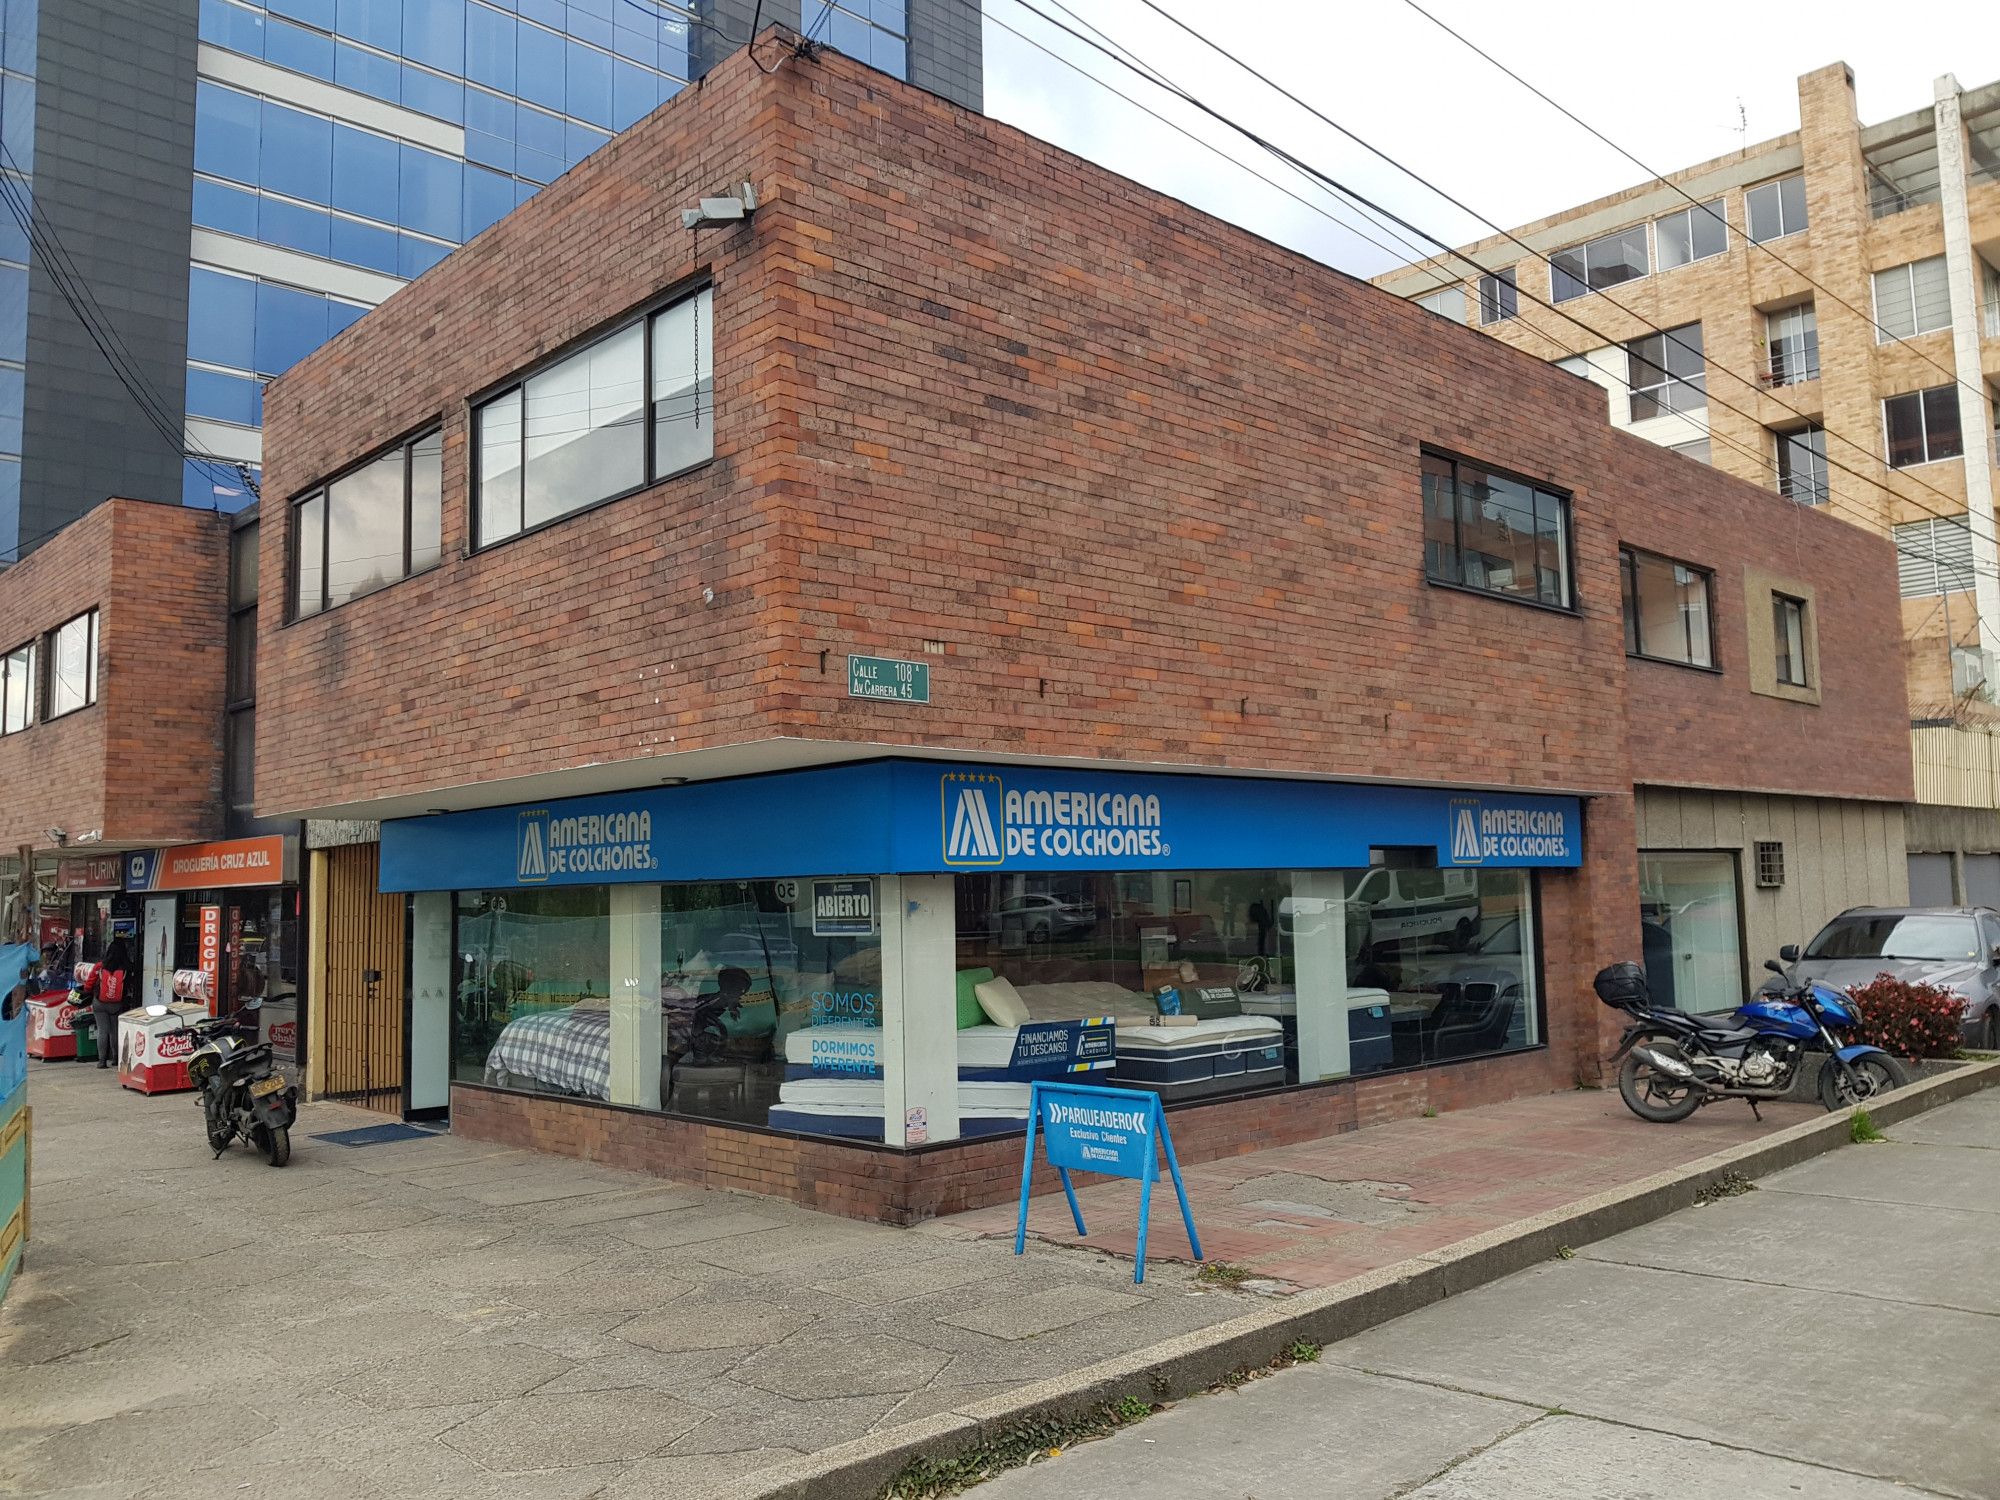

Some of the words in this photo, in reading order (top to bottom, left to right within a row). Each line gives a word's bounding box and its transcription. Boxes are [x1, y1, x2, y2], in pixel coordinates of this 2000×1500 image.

[894, 663, 912, 682] 108
[900, 683, 912, 698] 45
[1005, 789, 1161, 827] AMERICANA
[550, 809, 651, 848] AMERICANA
[1482, 809, 1563, 836] AMERICANA
[1006, 827, 1036, 856] DE
[1483, 836, 1499, 857] DE
[173, 853, 219, 874] DROGUERÍA
[220, 852, 245, 870] CRUZ
[246, 850, 270, 868] AZUL
[550, 849, 566, 874] DE
[817, 894, 870, 917] ABIERTO
[811, 991, 875, 1014] SOMOS
[812, 1040, 875, 1057] DORMIMOS
[1020, 1029, 1069, 1045] FINANCIAMOS
[1018, 1046, 1028, 1057] TU
[812, 1055, 876, 1074] DIFERENTE
[1061, 1106, 1133, 1131] PARQUEADERO
[1101, 1131, 1128, 1145] Clientes
